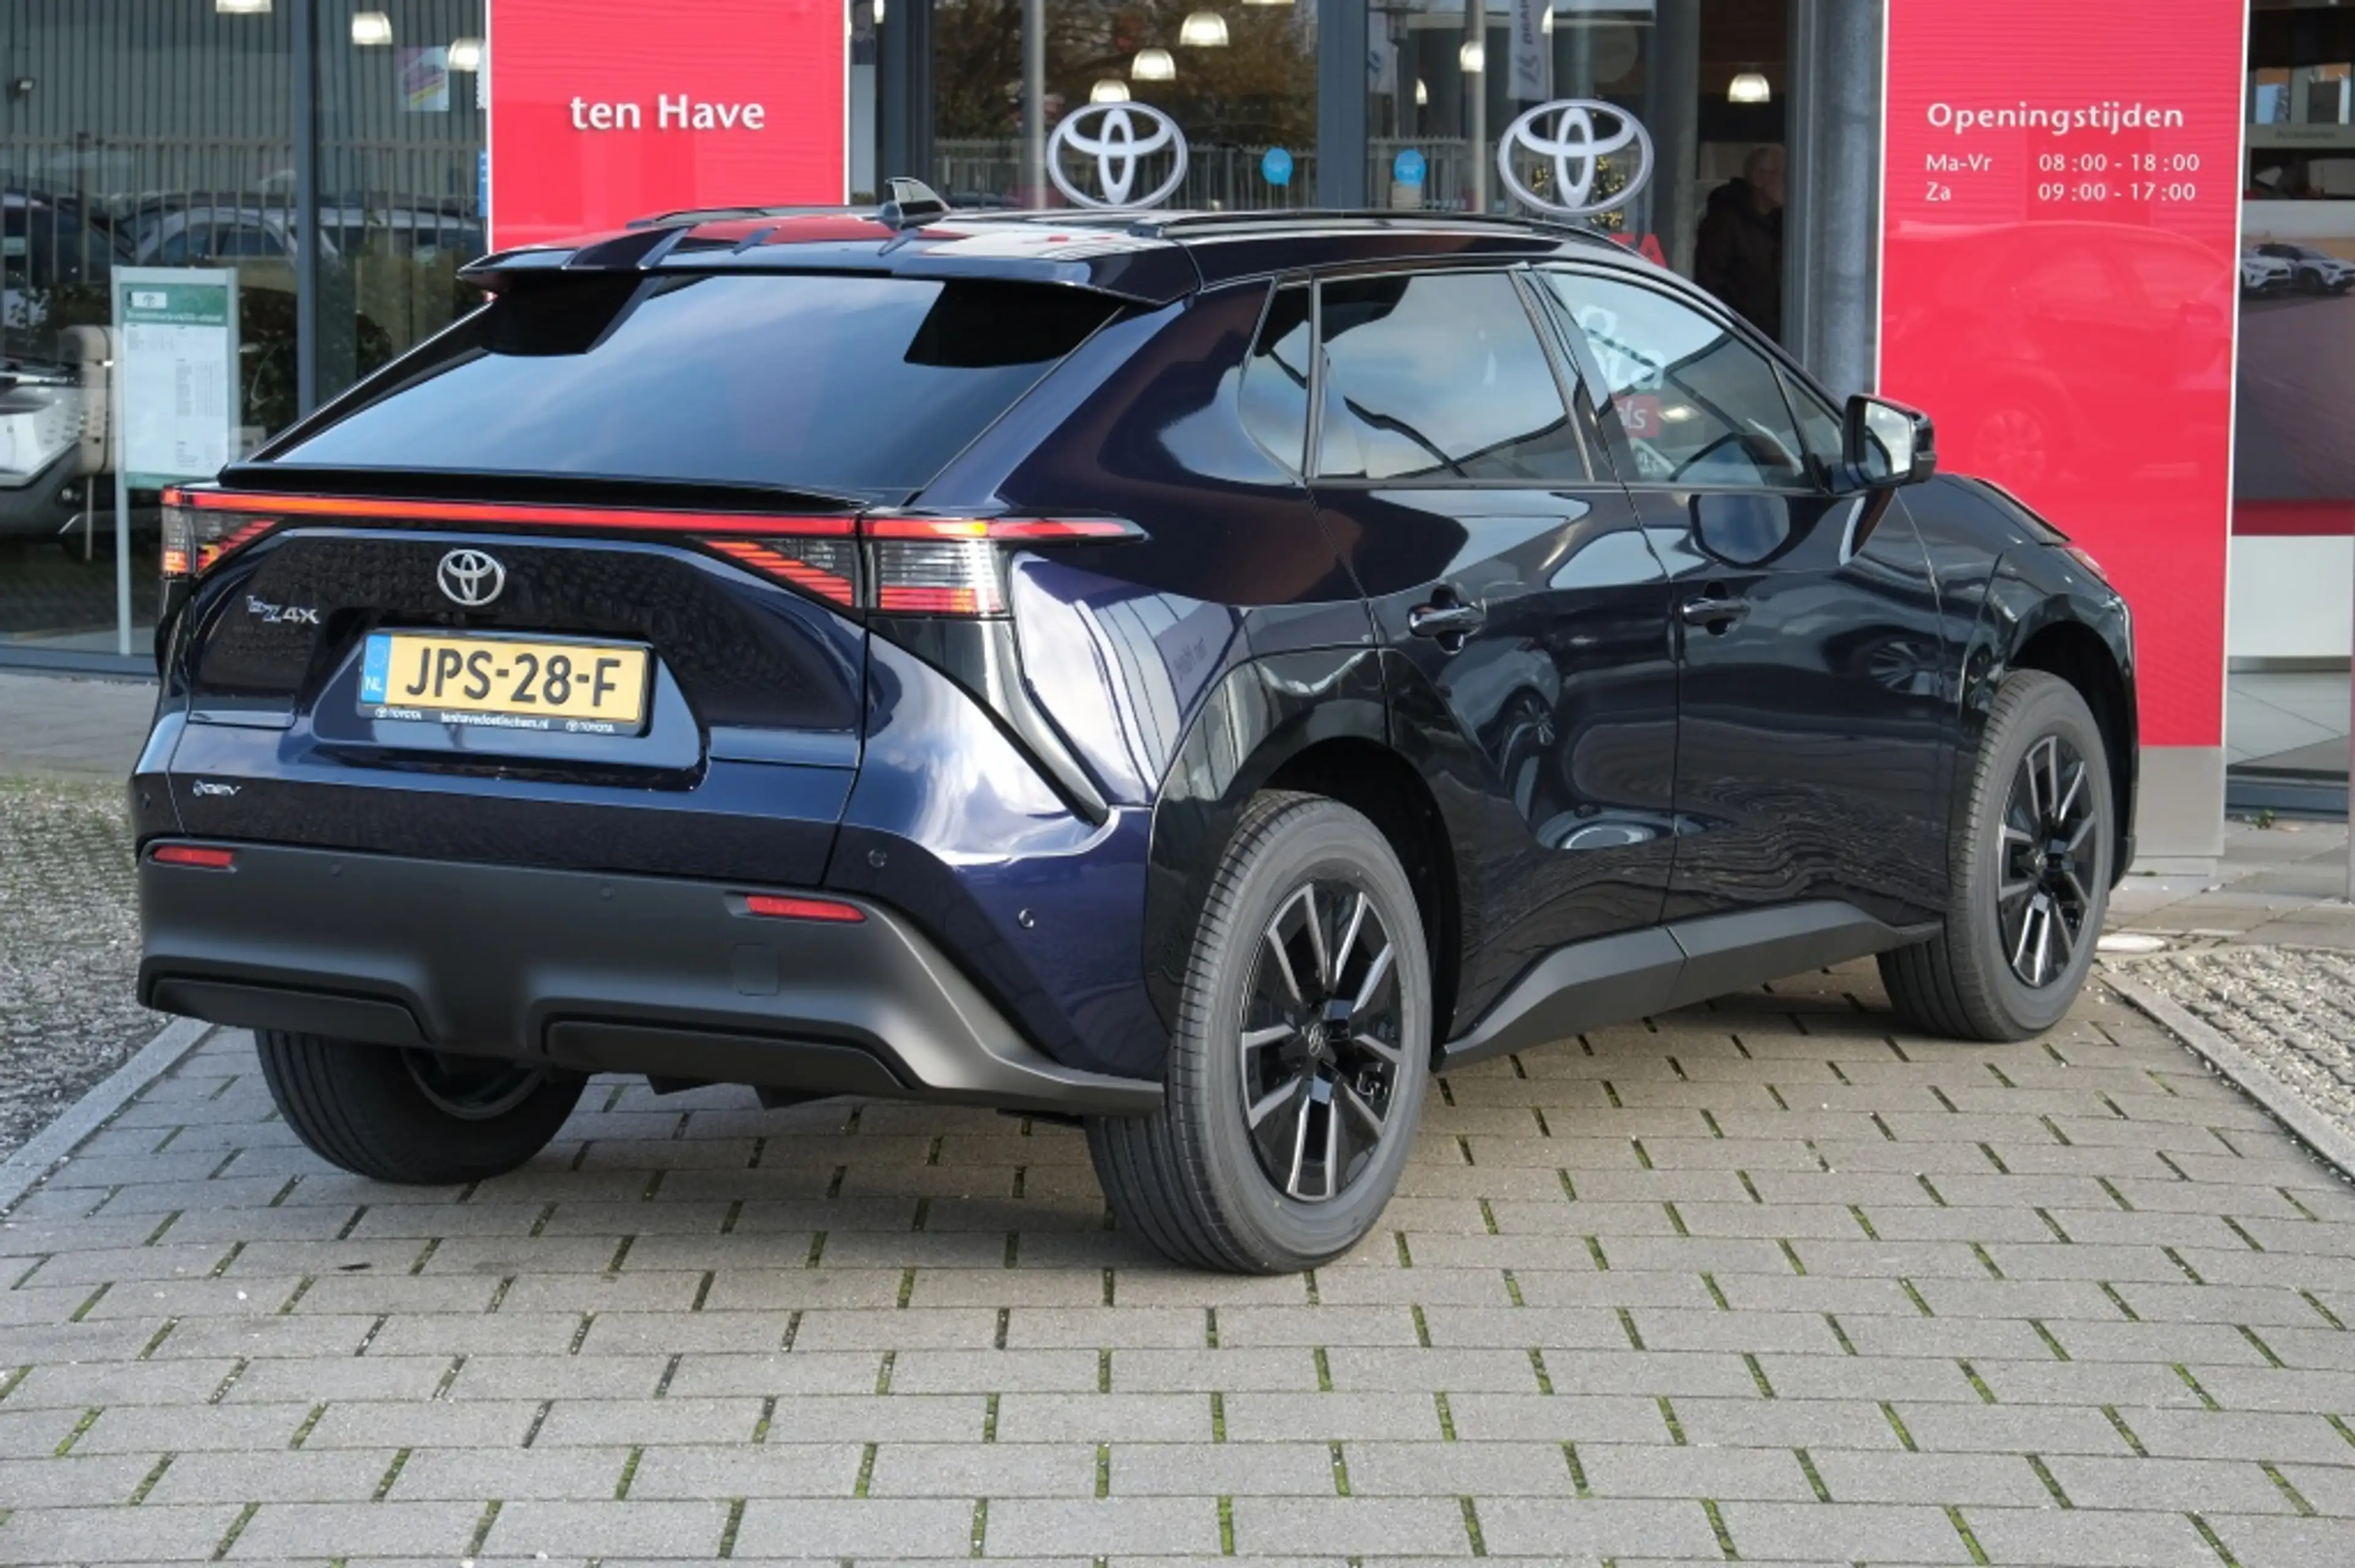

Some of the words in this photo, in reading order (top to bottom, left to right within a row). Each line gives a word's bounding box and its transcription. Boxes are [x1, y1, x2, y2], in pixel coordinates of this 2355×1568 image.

[570, 95, 641, 129] ten
[657, 94, 765, 129] Have
[1926, 101, 2184, 135] Openingstijden
[1925, 153, 1993, 171] Ma-Vr
[1925, 182, 1951, 201] Za
[364, 676, 383, 692] NL
[406, 647, 621, 706] JPS-28-F
